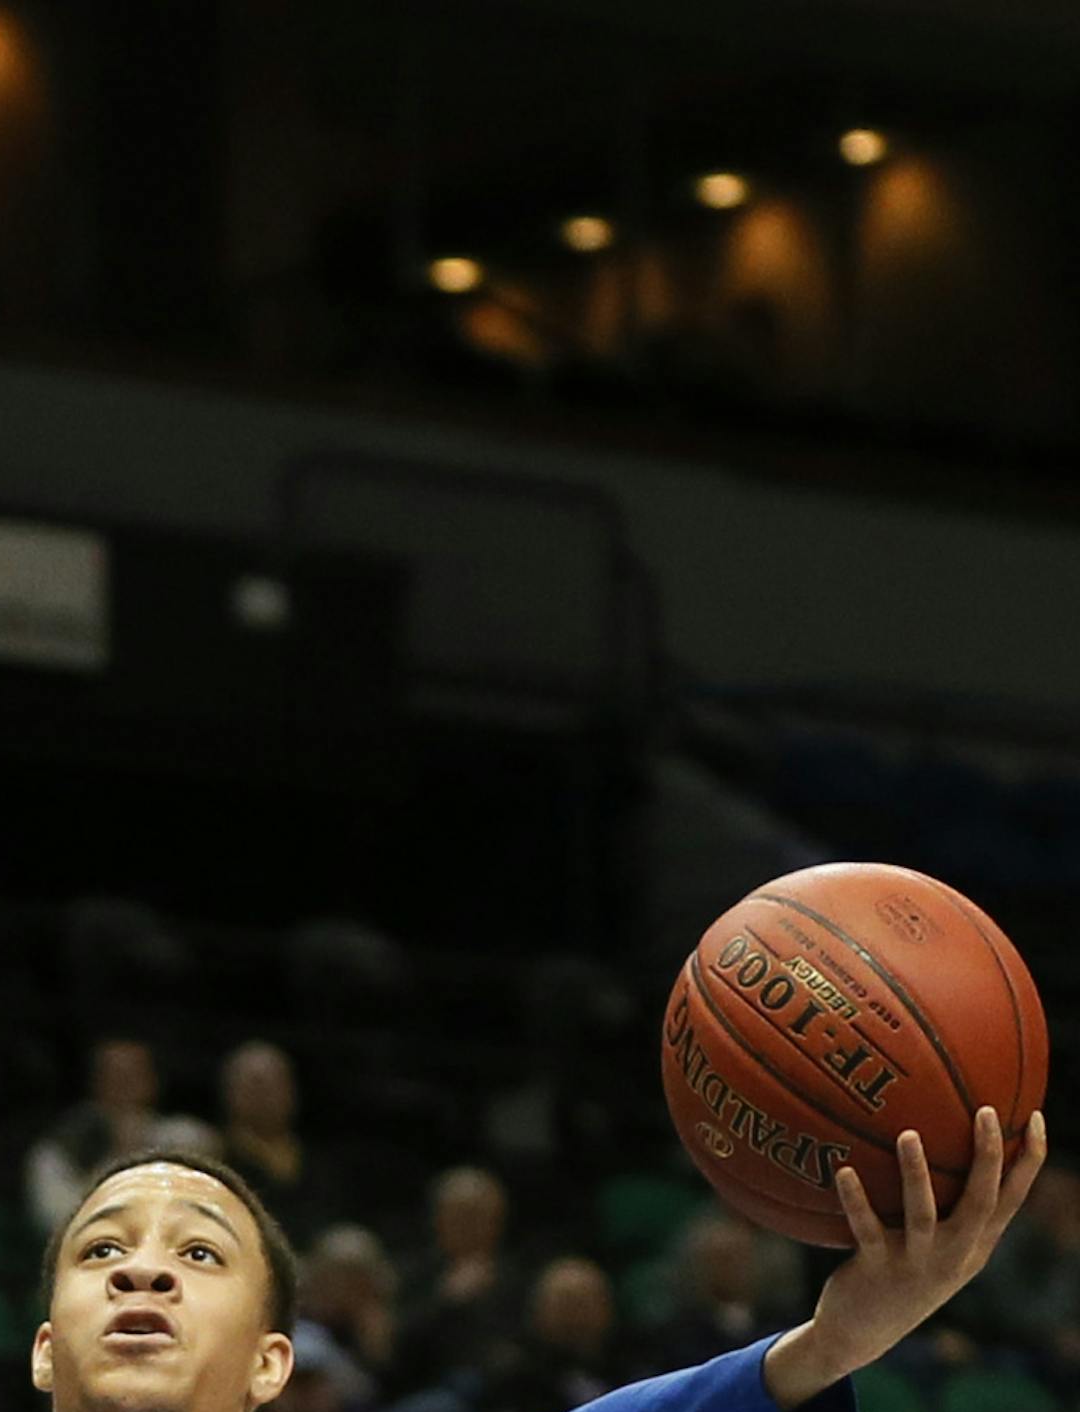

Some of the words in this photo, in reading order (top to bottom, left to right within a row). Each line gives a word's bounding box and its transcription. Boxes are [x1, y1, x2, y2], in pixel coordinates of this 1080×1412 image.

[782, 955, 858, 1022] LEGACY
[819, 950, 868, 999] CHANNEL
[717, 935, 898, 1111] TF-1000
[869, 1001, 901, 1033] DEEP
[666, 982, 851, 1190] SPALDING
